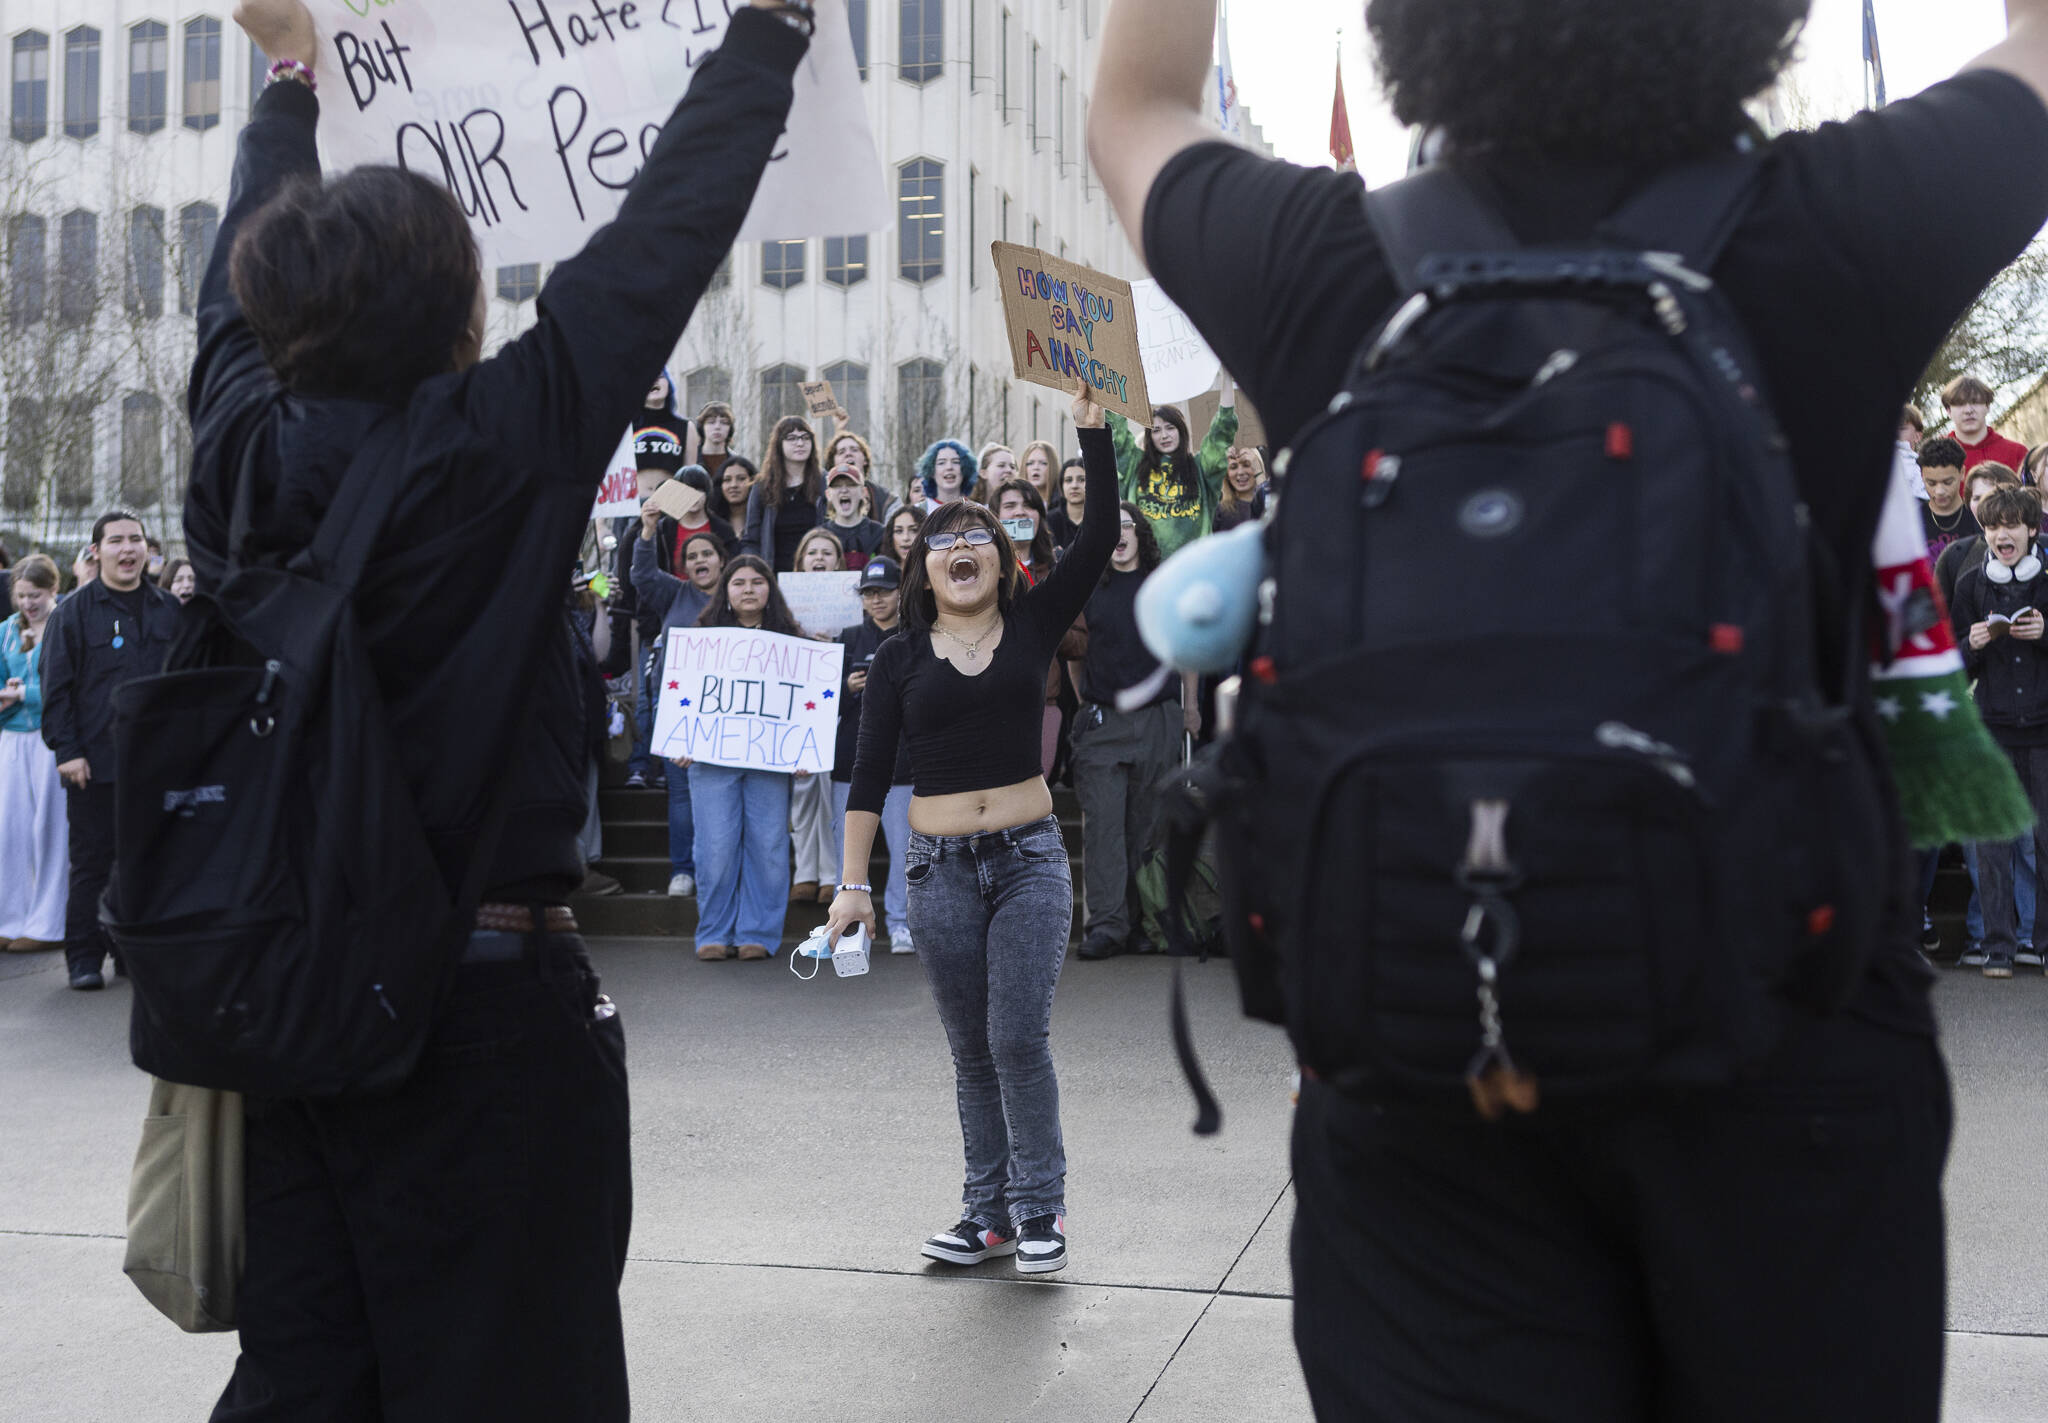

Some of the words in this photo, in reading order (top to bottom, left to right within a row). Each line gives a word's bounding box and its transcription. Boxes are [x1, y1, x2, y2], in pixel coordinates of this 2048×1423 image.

[333, 20, 411, 112] But
[507, 0, 641, 66] Hate
[1017, 267, 1068, 305] HOW
[1072, 282, 1114, 323] YOU
[1052, 305, 1094, 351] SAY
[1026, 329, 1128, 403] ANARCHY
[650, 441, 682, 456] YOU
[667, 634, 840, 682] IMMIGRANTS
[699, 675, 804, 720] BUILT
[662, 715, 822, 768] AMERICA
